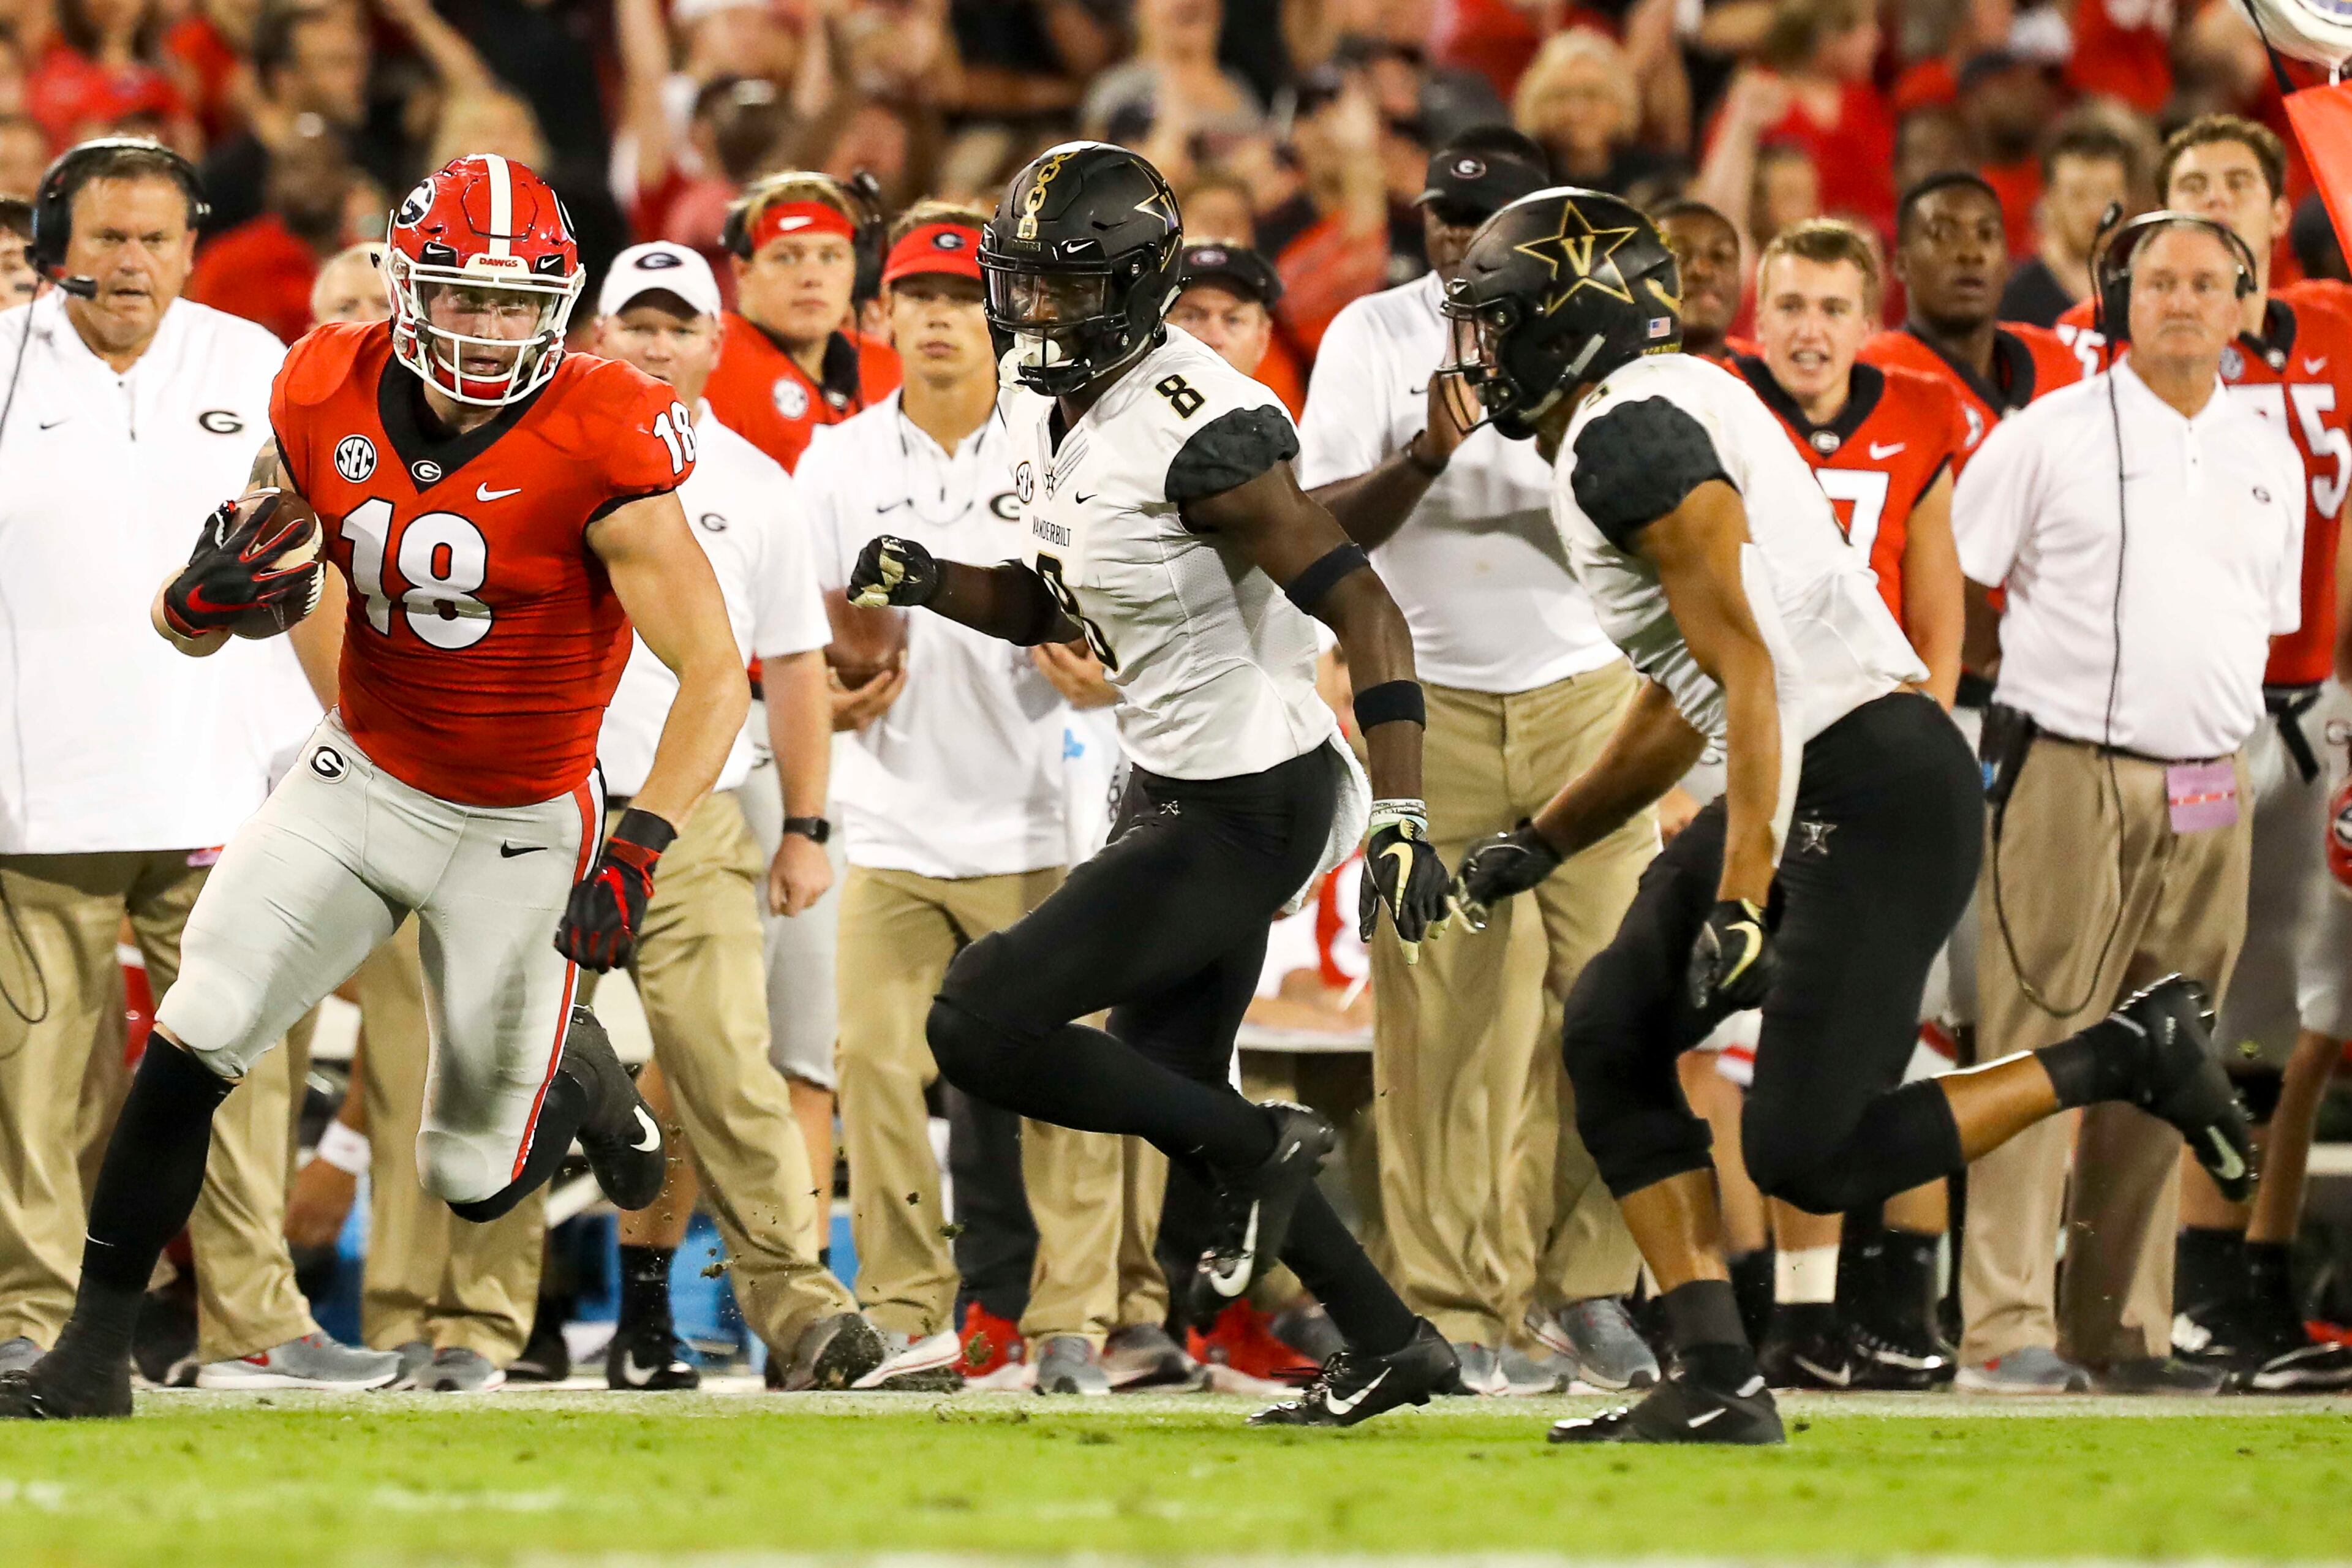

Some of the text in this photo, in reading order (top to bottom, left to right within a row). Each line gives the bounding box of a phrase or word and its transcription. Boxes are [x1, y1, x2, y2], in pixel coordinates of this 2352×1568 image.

[479, 257, 518, 267] DAWGS
[635, 252, 681, 270] G
[1561, 236, 1595, 277] V
[1156, 374, 1205, 420] 8
[200, 411, 243, 433] G
[654, 401, 696, 475] 18
[337, 437, 374, 480] SEC
[414, 461, 440, 480] G
[1033, 515, 1071, 547] VANDERBILT
[340, 497, 492, 650] 18
[311, 747, 347, 780] G
